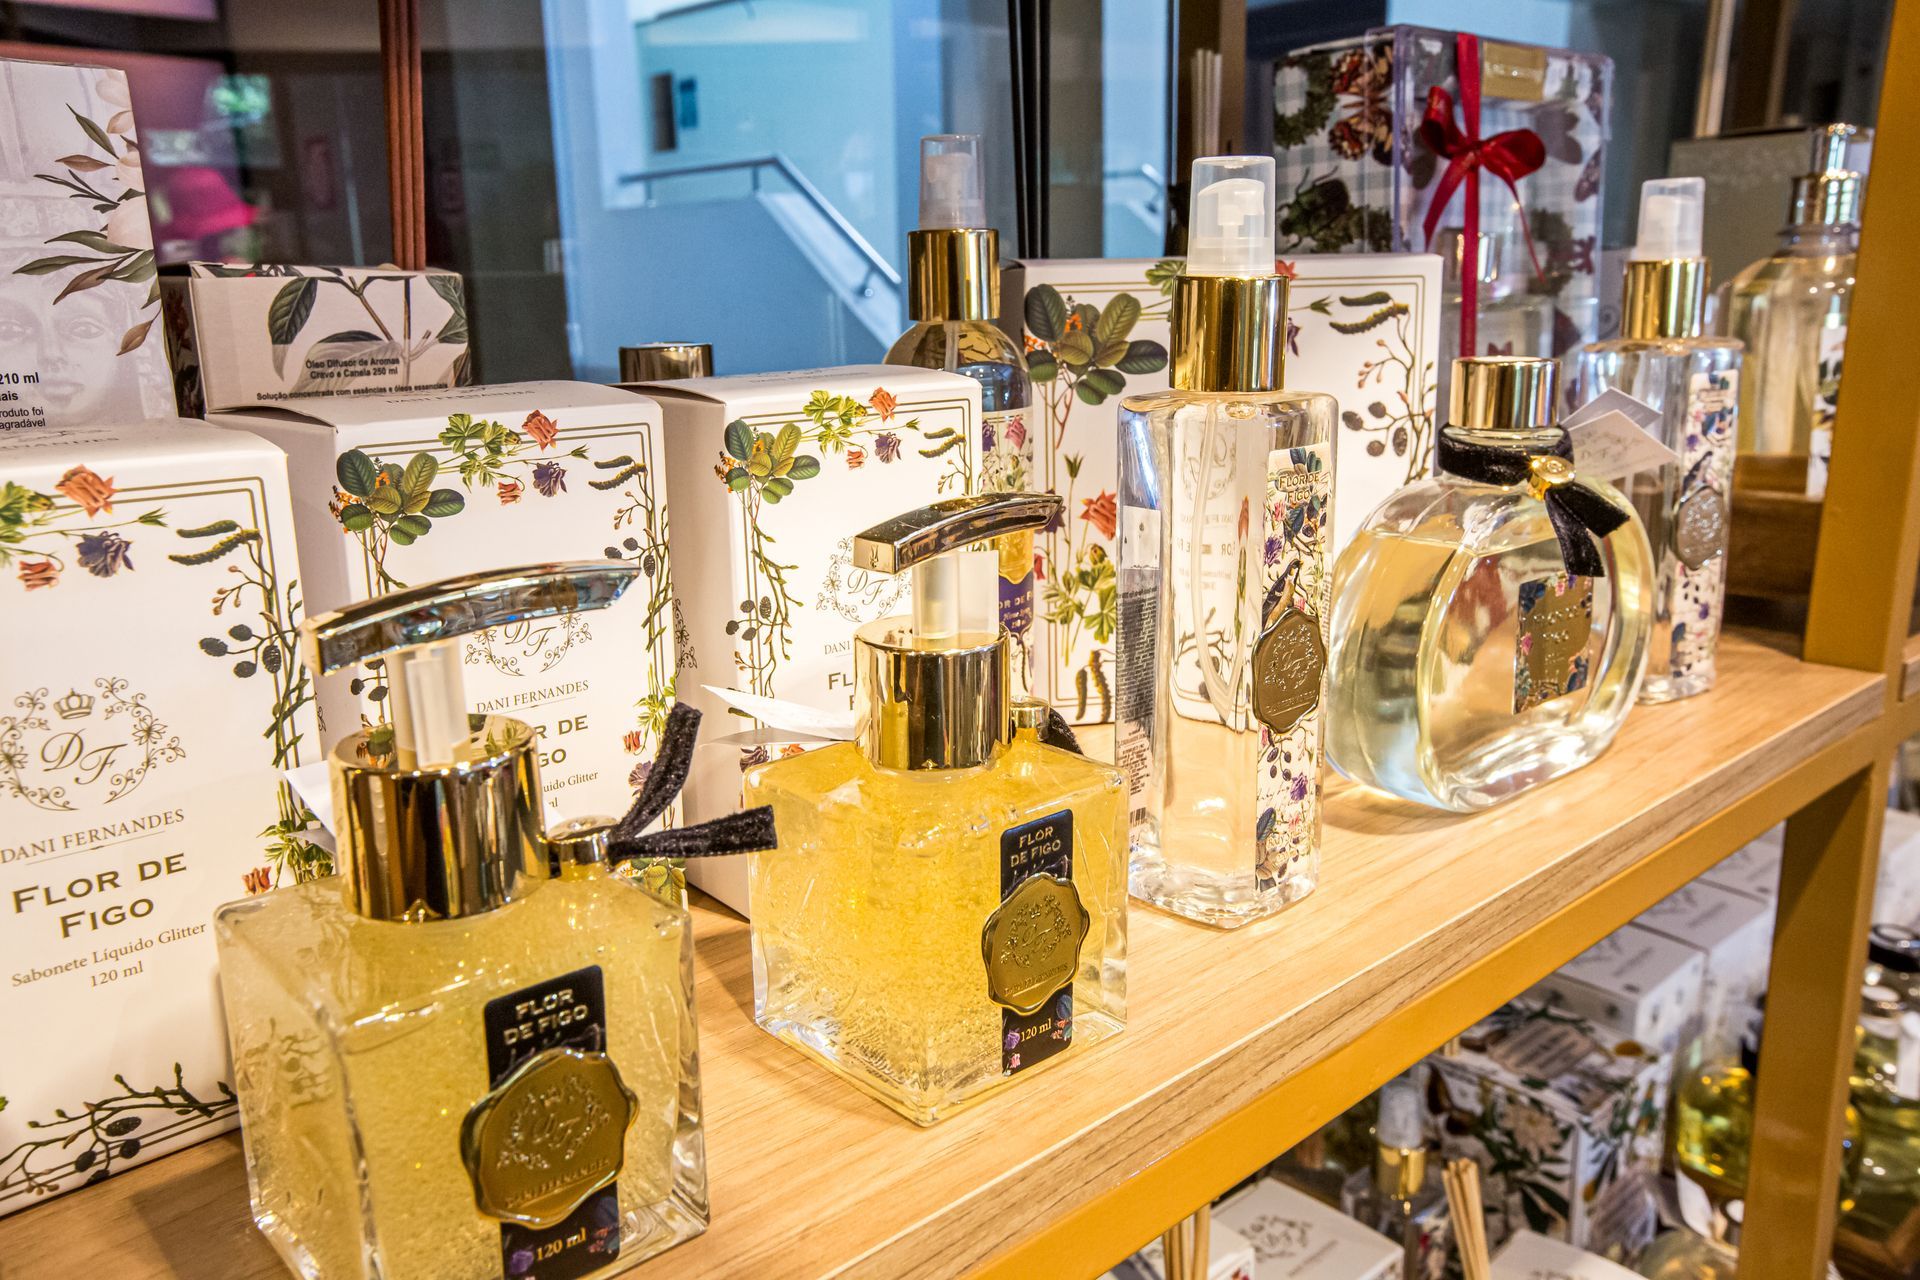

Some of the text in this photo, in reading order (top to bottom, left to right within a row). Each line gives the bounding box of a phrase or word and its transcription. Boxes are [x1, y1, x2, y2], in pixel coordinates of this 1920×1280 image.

[305, 358, 325, 369] Óleo
[327, 359, 357, 368] Difusor
[370, 357, 400, 365] Aromas
[310, 370, 334, 379] Cravo
[343, 368, 371, 377] Canela
[372, 367, 386, 375] 250
[388, 367, 398, 375] ml
[24, 372, 40, 384] ml
[0, 391, 19, 401] ais
[257, 392, 288, 401] Solução
[289, 389, 334, 398] concentrada
[32, 407, 44, 416] foi
[0, 418, 46, 430] agradável
[1279, 471, 1320, 488] FLOR DE
[1287, 489, 1310, 503] FIGO
[824, 640, 850, 655] DANI
[476, 680, 589, 713] DANI FERNANDES
[558, 714, 589, 736] DE
[568, 770, 599, 787] Glitter
[1, 808, 185, 864] DANI FERNANDES
[1019, 825, 1054, 849] FLOR
[1011, 838, 1062, 868] DE FIGO
[12, 853, 187, 914] FLOR DE
[60, 898, 154, 939] FIGO
[12, 922, 207, 988] Sabonete Líquido Glitter
[91, 961, 144, 987] 120 ml
[515, 988, 575, 1020] FLOR
[503, 1004, 589, 1046] DE FIGO
[1021, 1018, 1052, 1042] 120 ml
[537, 1227, 587, 1262] 120 ml
